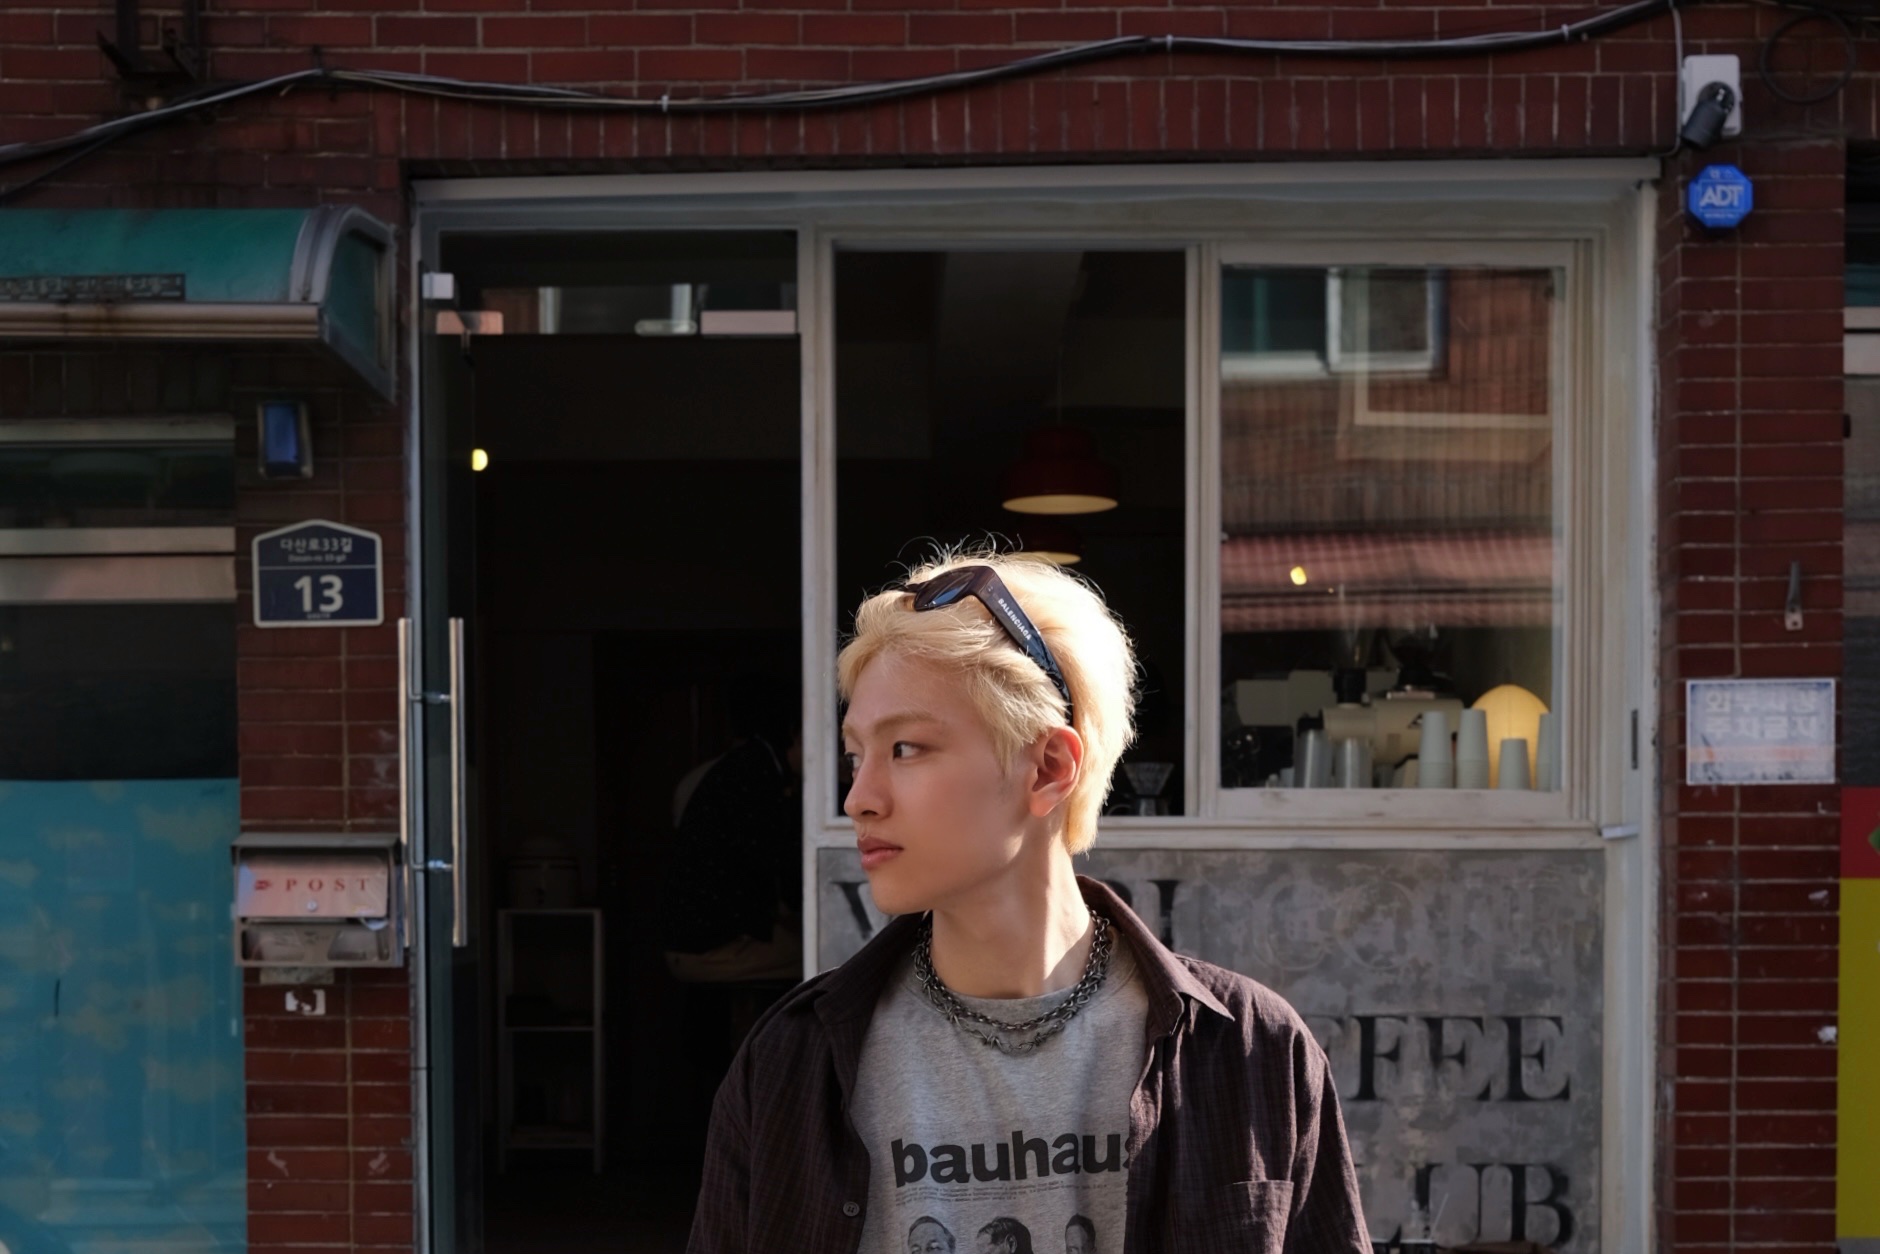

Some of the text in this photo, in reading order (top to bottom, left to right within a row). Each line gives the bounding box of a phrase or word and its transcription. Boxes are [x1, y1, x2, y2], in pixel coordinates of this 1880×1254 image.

[1701, 186, 1742, 206] ADT
[293, 575, 344, 613] 13
[998, 598, 1032, 641] BALENCIAGA
[285, 879, 370, 892] POST
